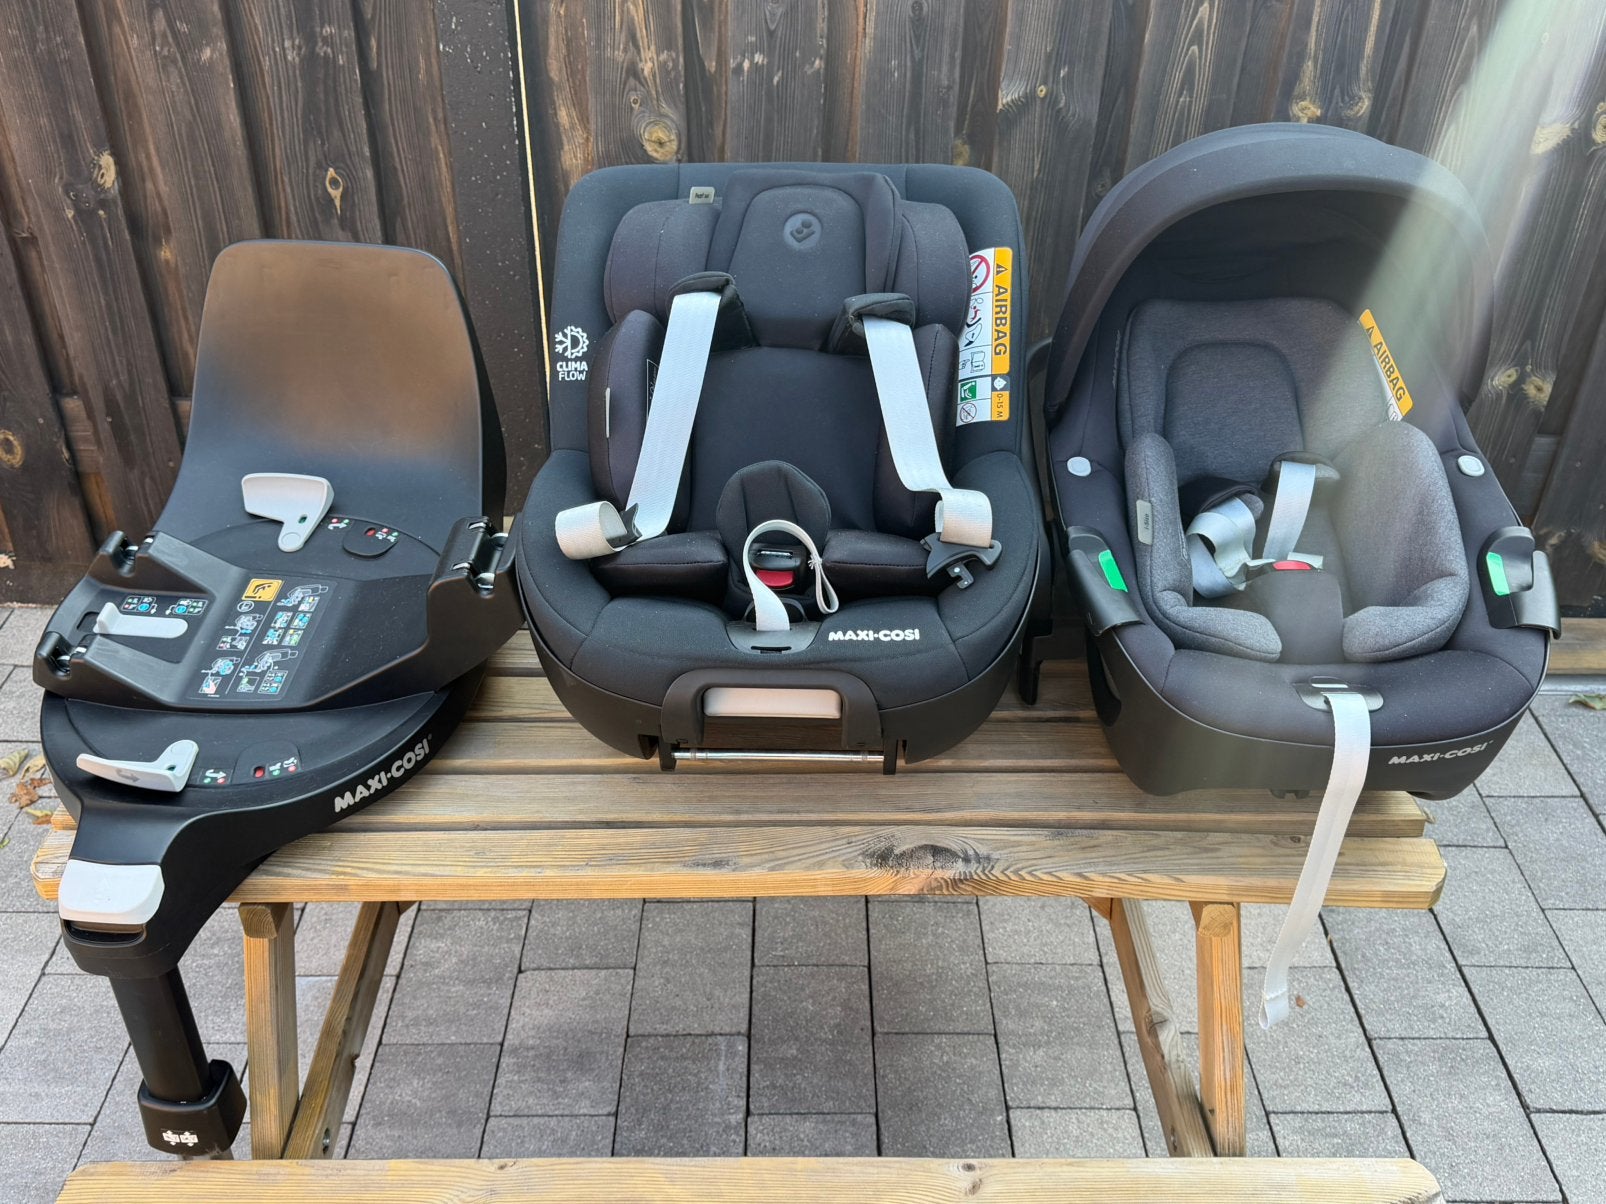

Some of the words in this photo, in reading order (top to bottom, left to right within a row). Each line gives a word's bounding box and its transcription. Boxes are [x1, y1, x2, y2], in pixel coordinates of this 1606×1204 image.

[994, 284, 1008, 356] AIRBAG
[556, 361, 588, 371] CLIMA
[1373, 341, 1406, 402] AIRBAG
[558, 371, 586, 381] FLOW
[996, 393, 1004, 409] 0-15
